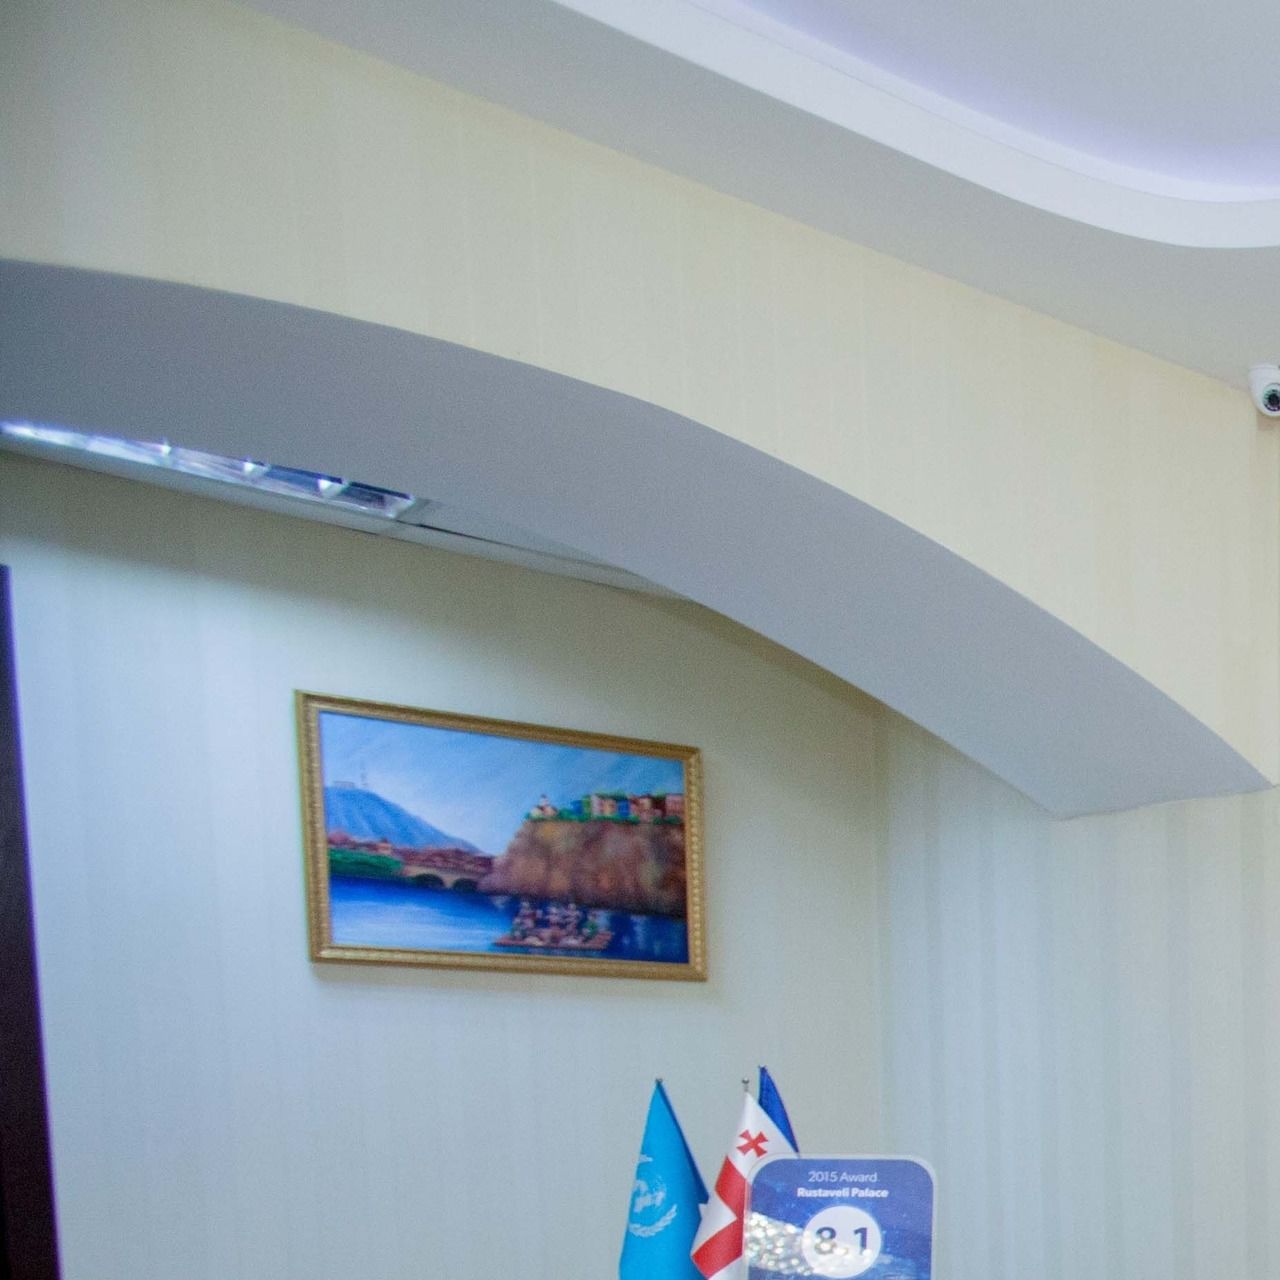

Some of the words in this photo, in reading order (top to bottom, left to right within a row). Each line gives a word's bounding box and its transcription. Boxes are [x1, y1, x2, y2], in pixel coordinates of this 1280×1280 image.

[808, 1171, 838, 1183] 2015
[840, 1172, 878, 1183] Award
[797, 1187, 849, 1198] Rustaveli
[851, 1187, 889, 1198] Palace
